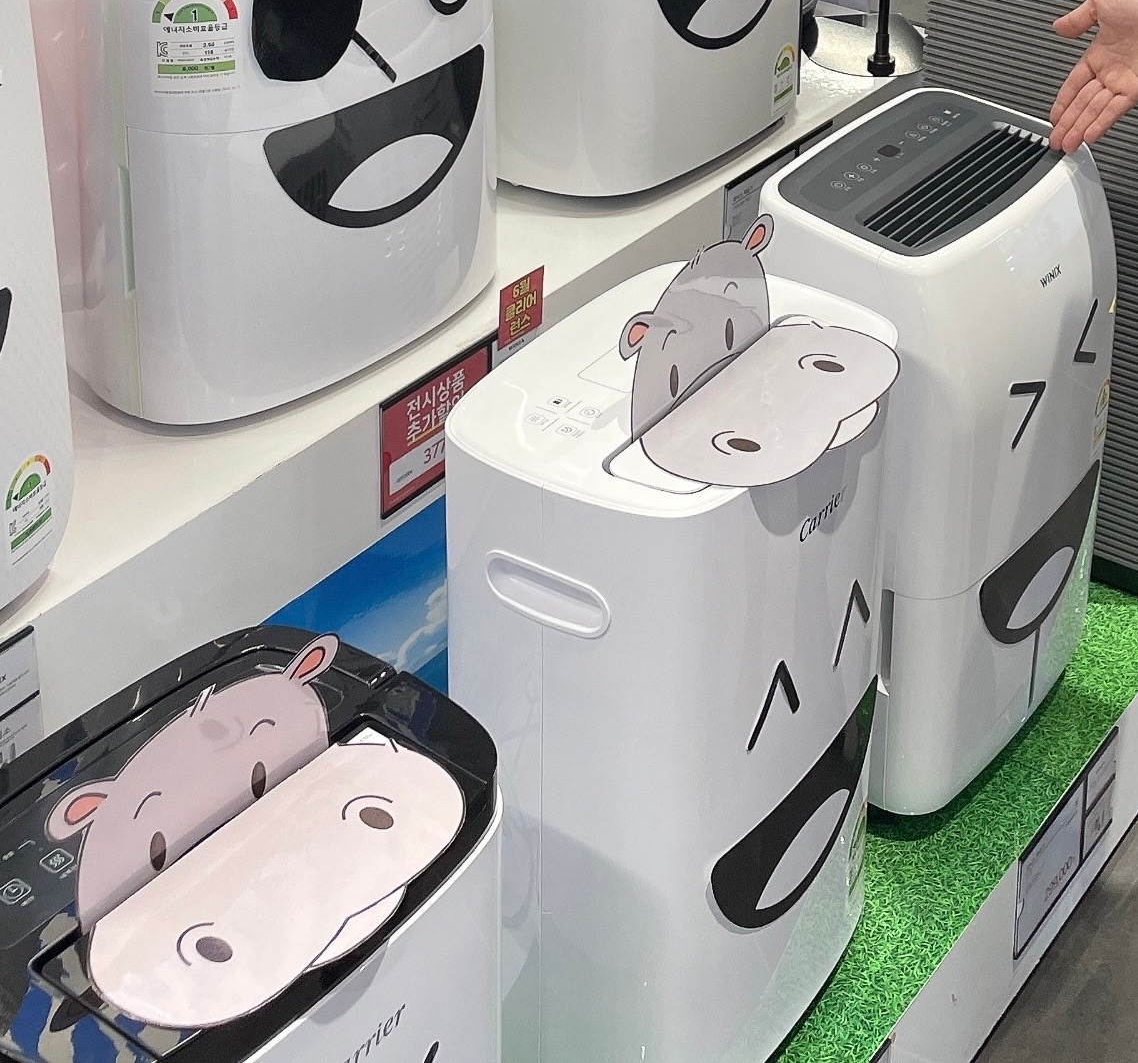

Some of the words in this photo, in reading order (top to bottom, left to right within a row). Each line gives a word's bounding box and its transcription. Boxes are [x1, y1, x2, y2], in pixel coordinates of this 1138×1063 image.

[512, 275, 531, 299] 6월
[1039, 264, 1061, 288] WINIX
[504, 289, 537, 322] 클리어
[509, 314, 531, 337] 런스
[406, 368, 466, 423] 전시상품
